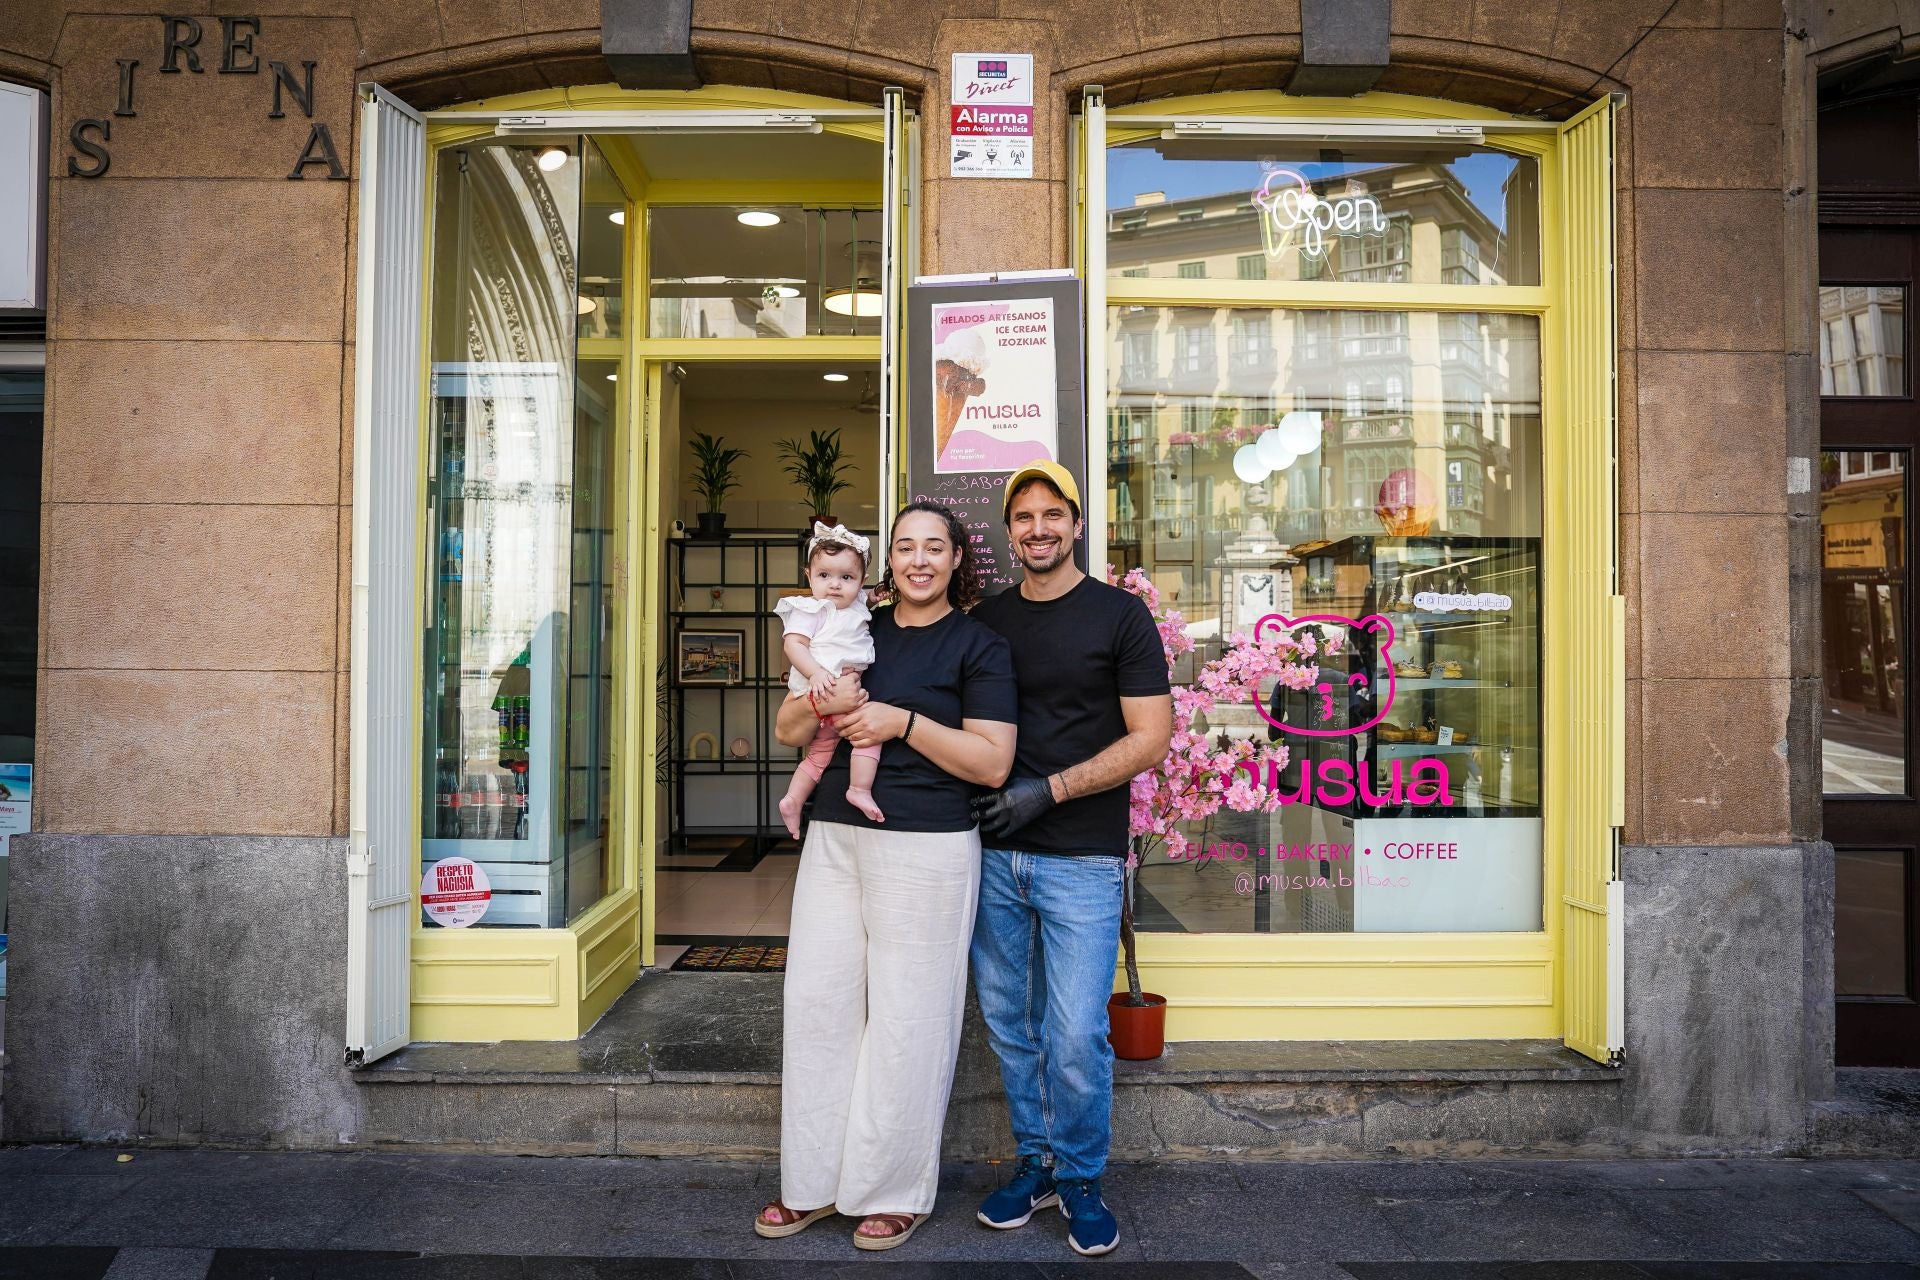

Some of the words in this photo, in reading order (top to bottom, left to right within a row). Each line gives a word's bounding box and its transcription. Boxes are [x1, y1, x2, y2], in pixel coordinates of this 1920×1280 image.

[965, 77, 1022, 98] Direct
[68, 16, 349, 180] SIRENA
[957, 107, 1028, 124] Alarma
[1273, 189, 1386, 256] Open
[941, 314, 985, 325] HELADOS
[988, 311, 1047, 322] ARTESANOS
[995, 326, 1010, 334] ICE
[1013, 324, 1047, 333] CREAM
[998, 337, 1047, 347] IZOZKIAK
[966, 403, 1042, 420] musua
[957, 475, 1010, 490] SABO
[1170, 842, 1249, 861] ELATO
[1277, 843, 1352, 861] BAKERY
[1384, 843, 1458, 860] COFFEE
[436, 864, 474, 877] RESPETO
[437, 876, 475, 892] NAGUSIA
[1235, 864, 1412, 896] @musua.bilbao
